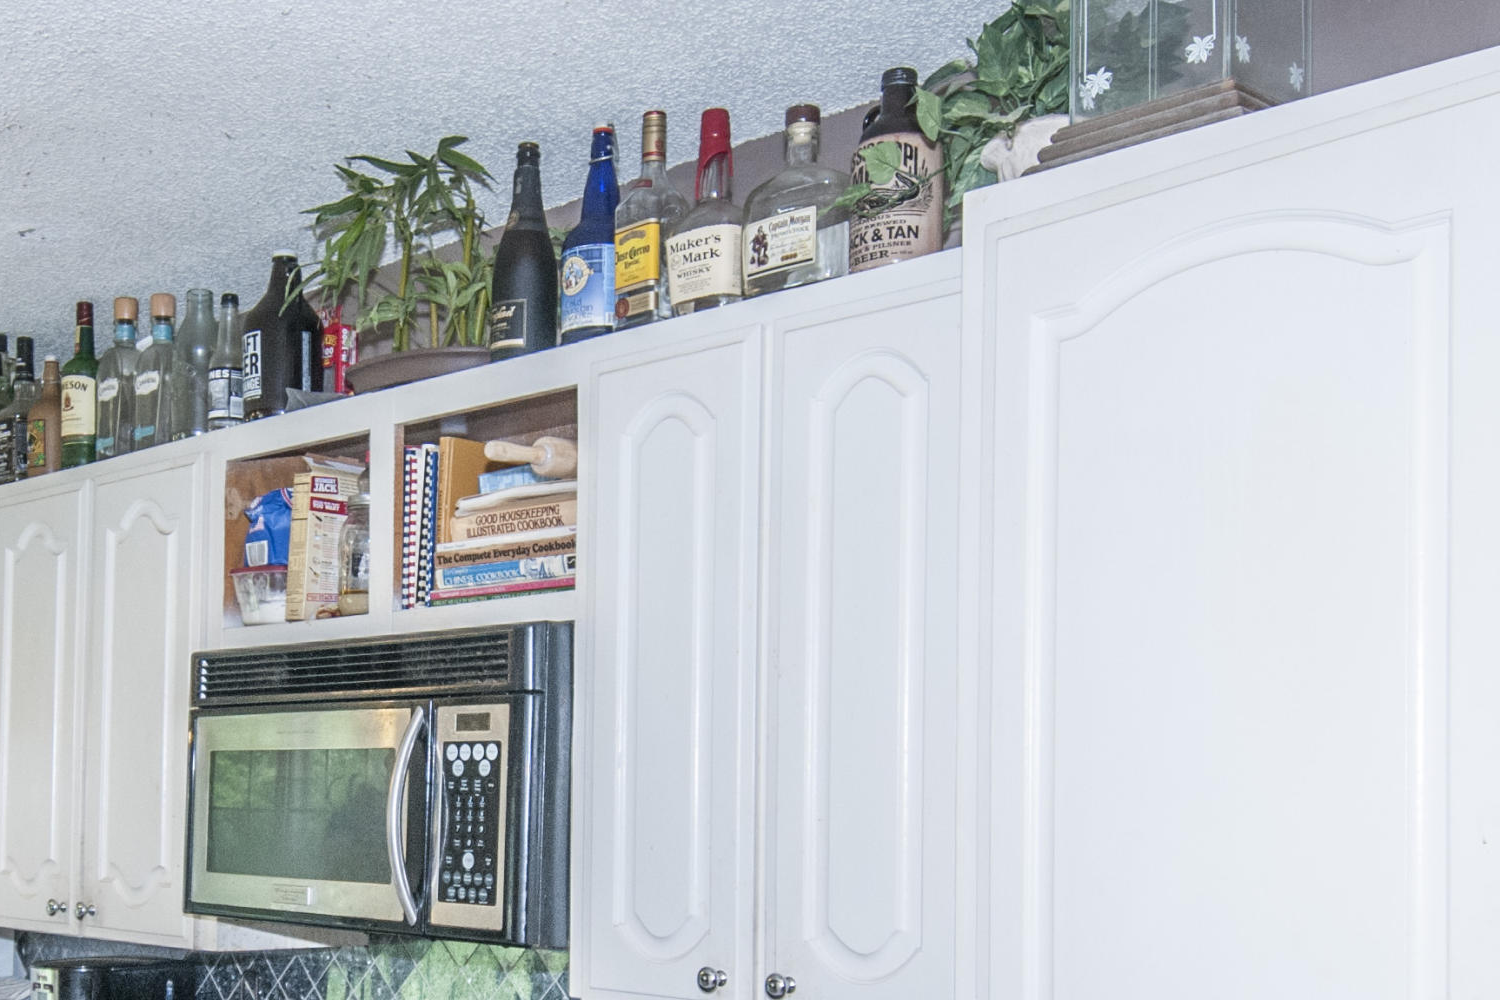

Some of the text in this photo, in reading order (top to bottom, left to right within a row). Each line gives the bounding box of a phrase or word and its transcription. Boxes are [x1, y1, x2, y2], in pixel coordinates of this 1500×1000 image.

[871, 228, 883, 242] &
[886, 225, 919, 240] TAN
[670, 234, 721, 255] Maker's
[682, 247, 721, 265] Mark
[313, 483, 337, 493] JACK
[475, 504, 560, 526] GOOD HOUSEKEEPING
[466, 515, 564, 538] ILLUSTRATED COOKBOOK
[436, 554, 453, 565] The
[492, 545, 531, 560] Everyday
